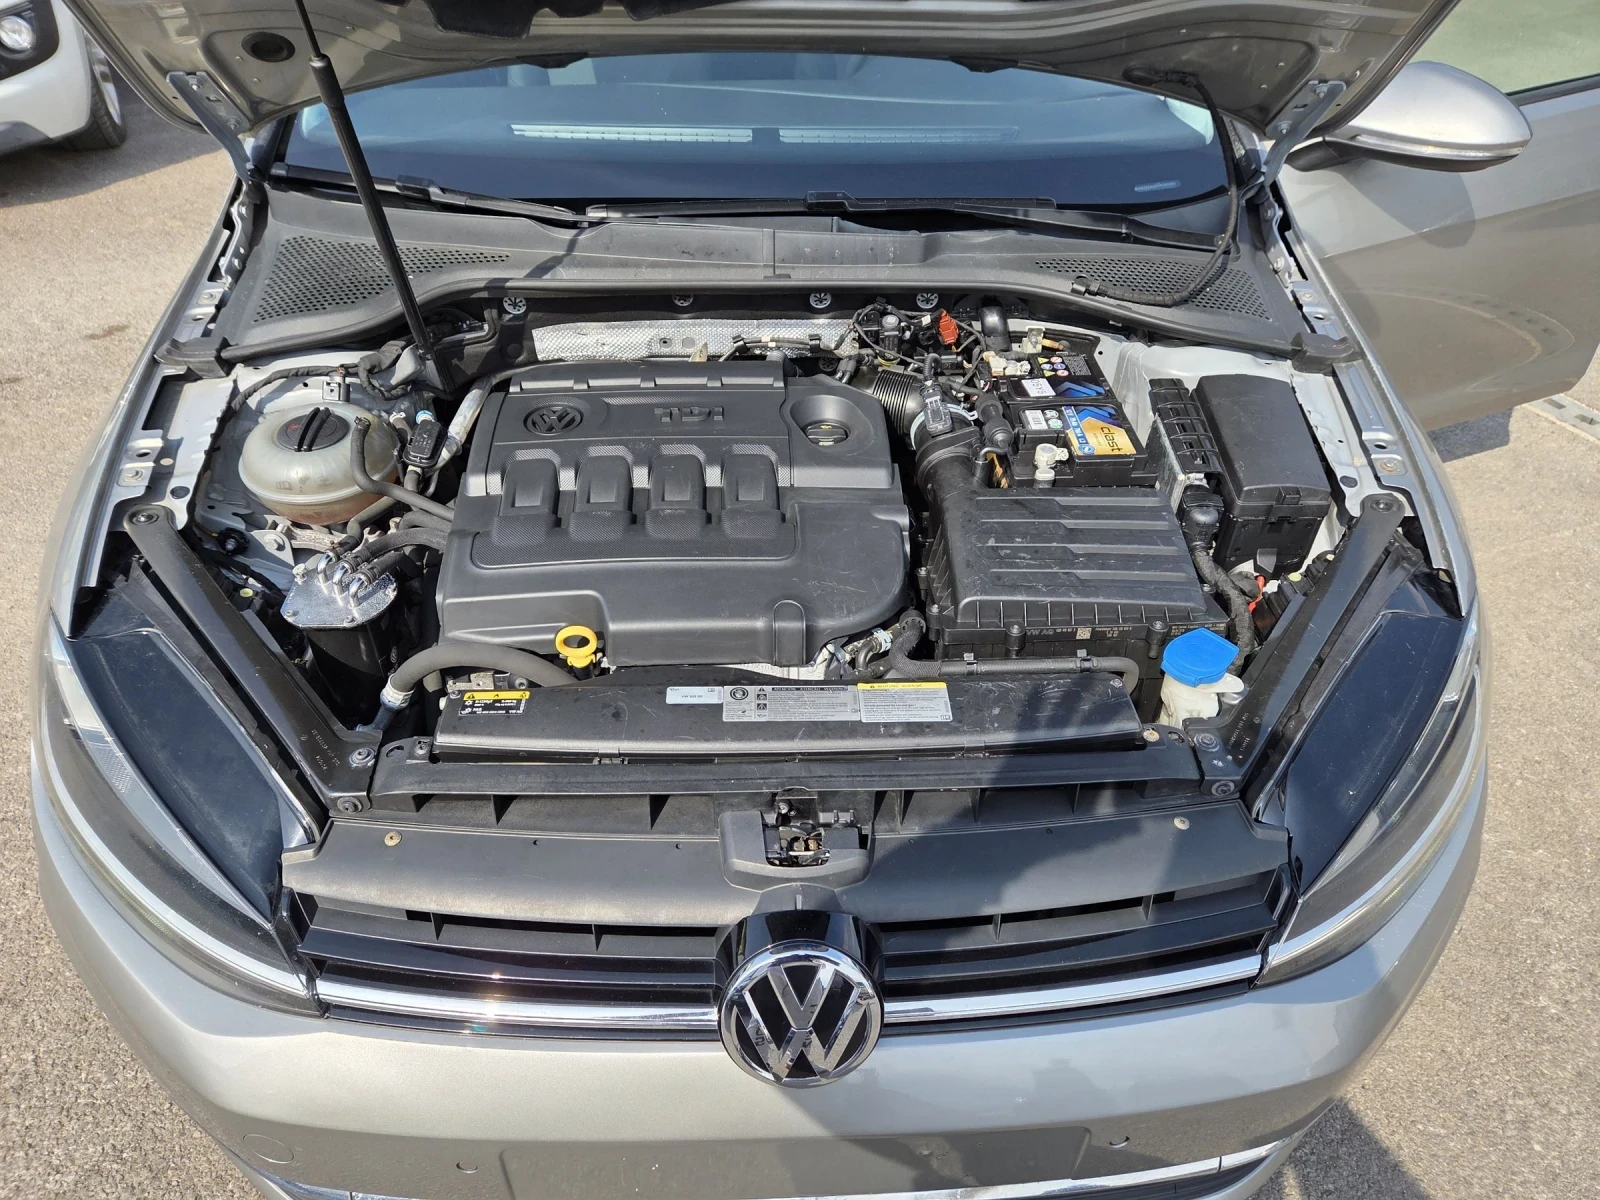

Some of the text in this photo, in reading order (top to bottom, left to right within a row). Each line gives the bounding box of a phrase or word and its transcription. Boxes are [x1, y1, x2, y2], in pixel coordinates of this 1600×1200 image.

[524, 402, 583, 435] VW
[654, 406, 724, 423] TDI
[1101, 426, 1124, 452] clast
[722, 945, 880, 1087] VW
